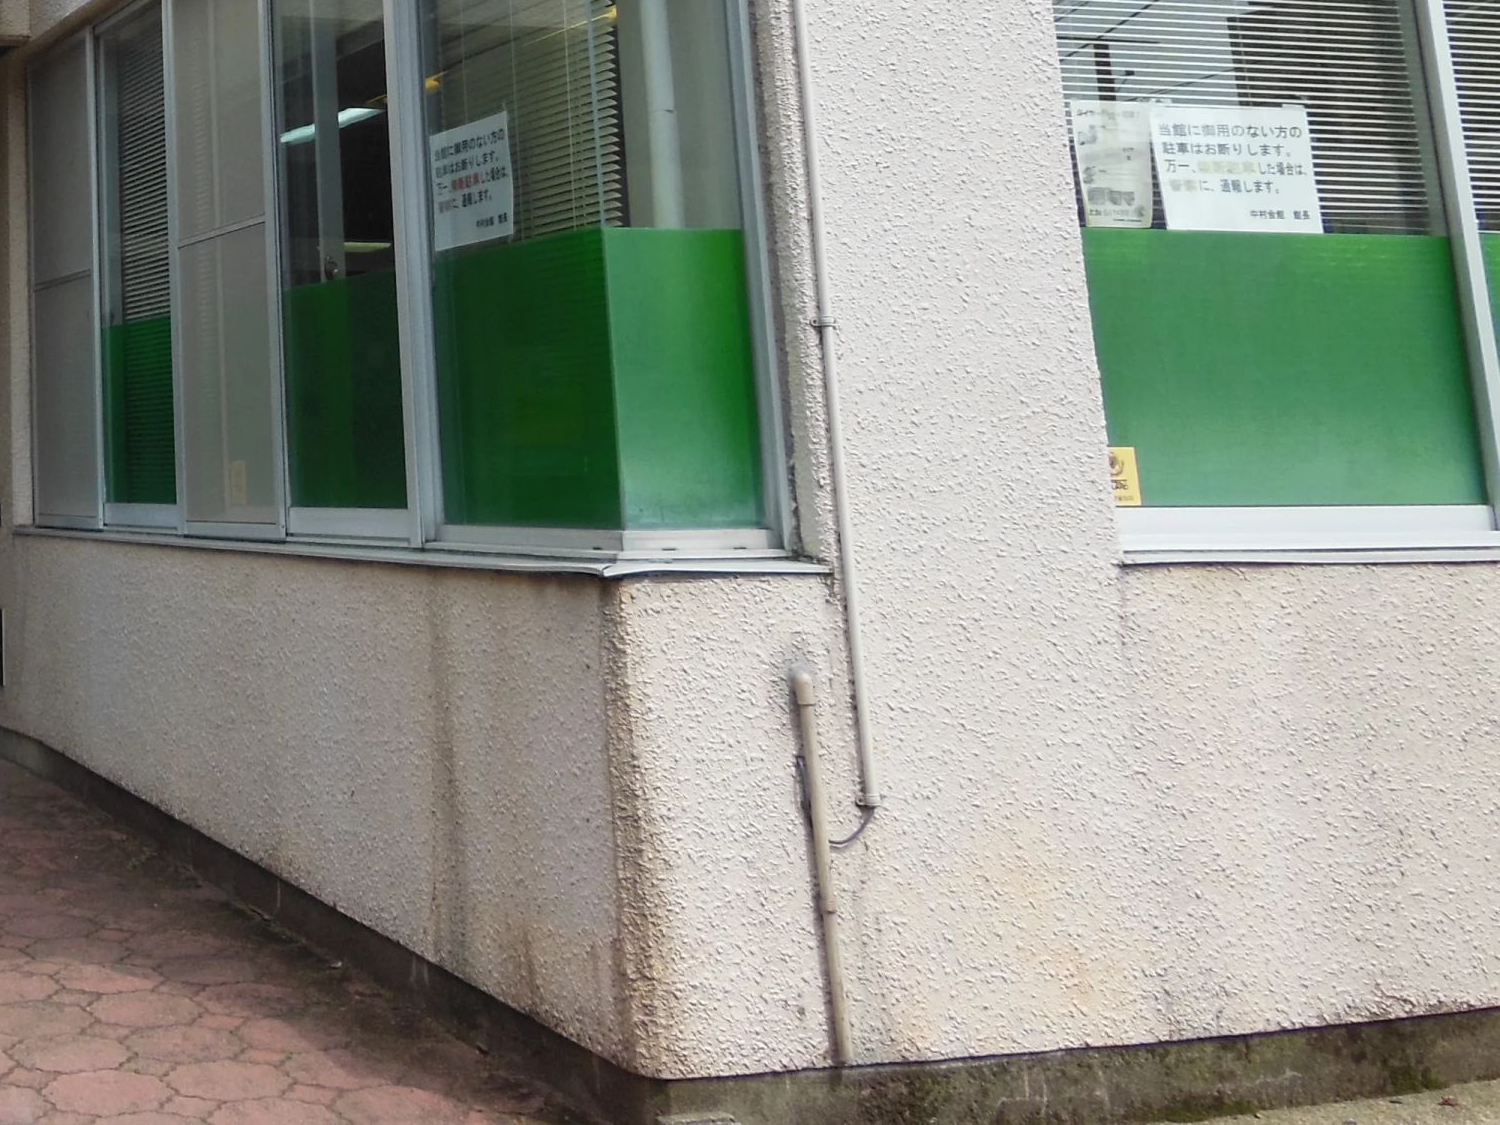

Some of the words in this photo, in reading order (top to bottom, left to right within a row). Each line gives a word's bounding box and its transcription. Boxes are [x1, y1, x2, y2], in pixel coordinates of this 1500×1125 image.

[1162, 142, 1292, 157] 駐車はお断りします。
[1164, 159, 1308, 176] 万一、した場合は、
[1169, 179, 1281, 194] に、通報します。
